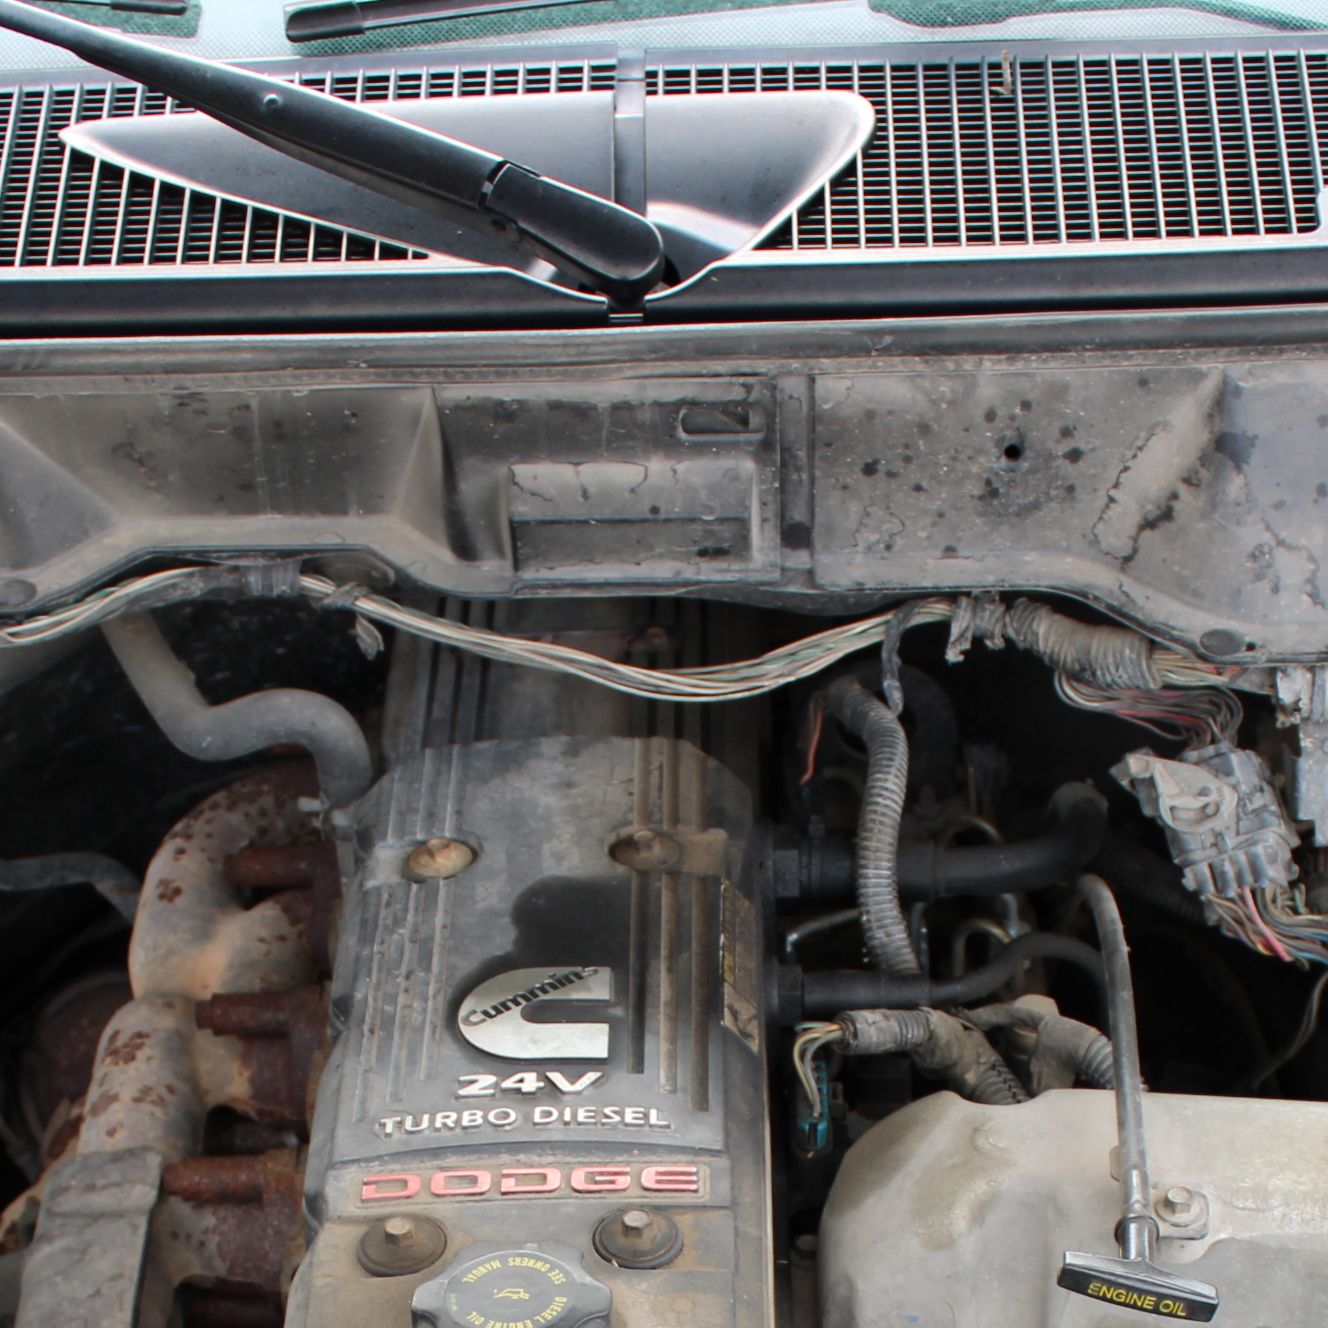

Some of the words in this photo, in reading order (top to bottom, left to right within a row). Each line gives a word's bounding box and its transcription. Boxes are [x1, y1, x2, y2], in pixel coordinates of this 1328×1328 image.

[460, 966, 599, 1027] Cummins
[456, 1070, 603, 1099] 24V
[379, 1107, 517, 1137] TURBO
[532, 1106, 673, 1130] DIESEL
[361, 1164, 699, 1200] DODGE
[461, 1259, 503, 1283] MANUAL
[507, 1256, 551, 1272] OWNERS
[546, 1268, 567, 1285] SEE
[533, 1296, 568, 1324] DIESEL
[1087, 1282, 1157, 1310] ENGINE
[1159, 1300, 1187, 1316] OIL
[466, 1311, 486, 1326] OIL
